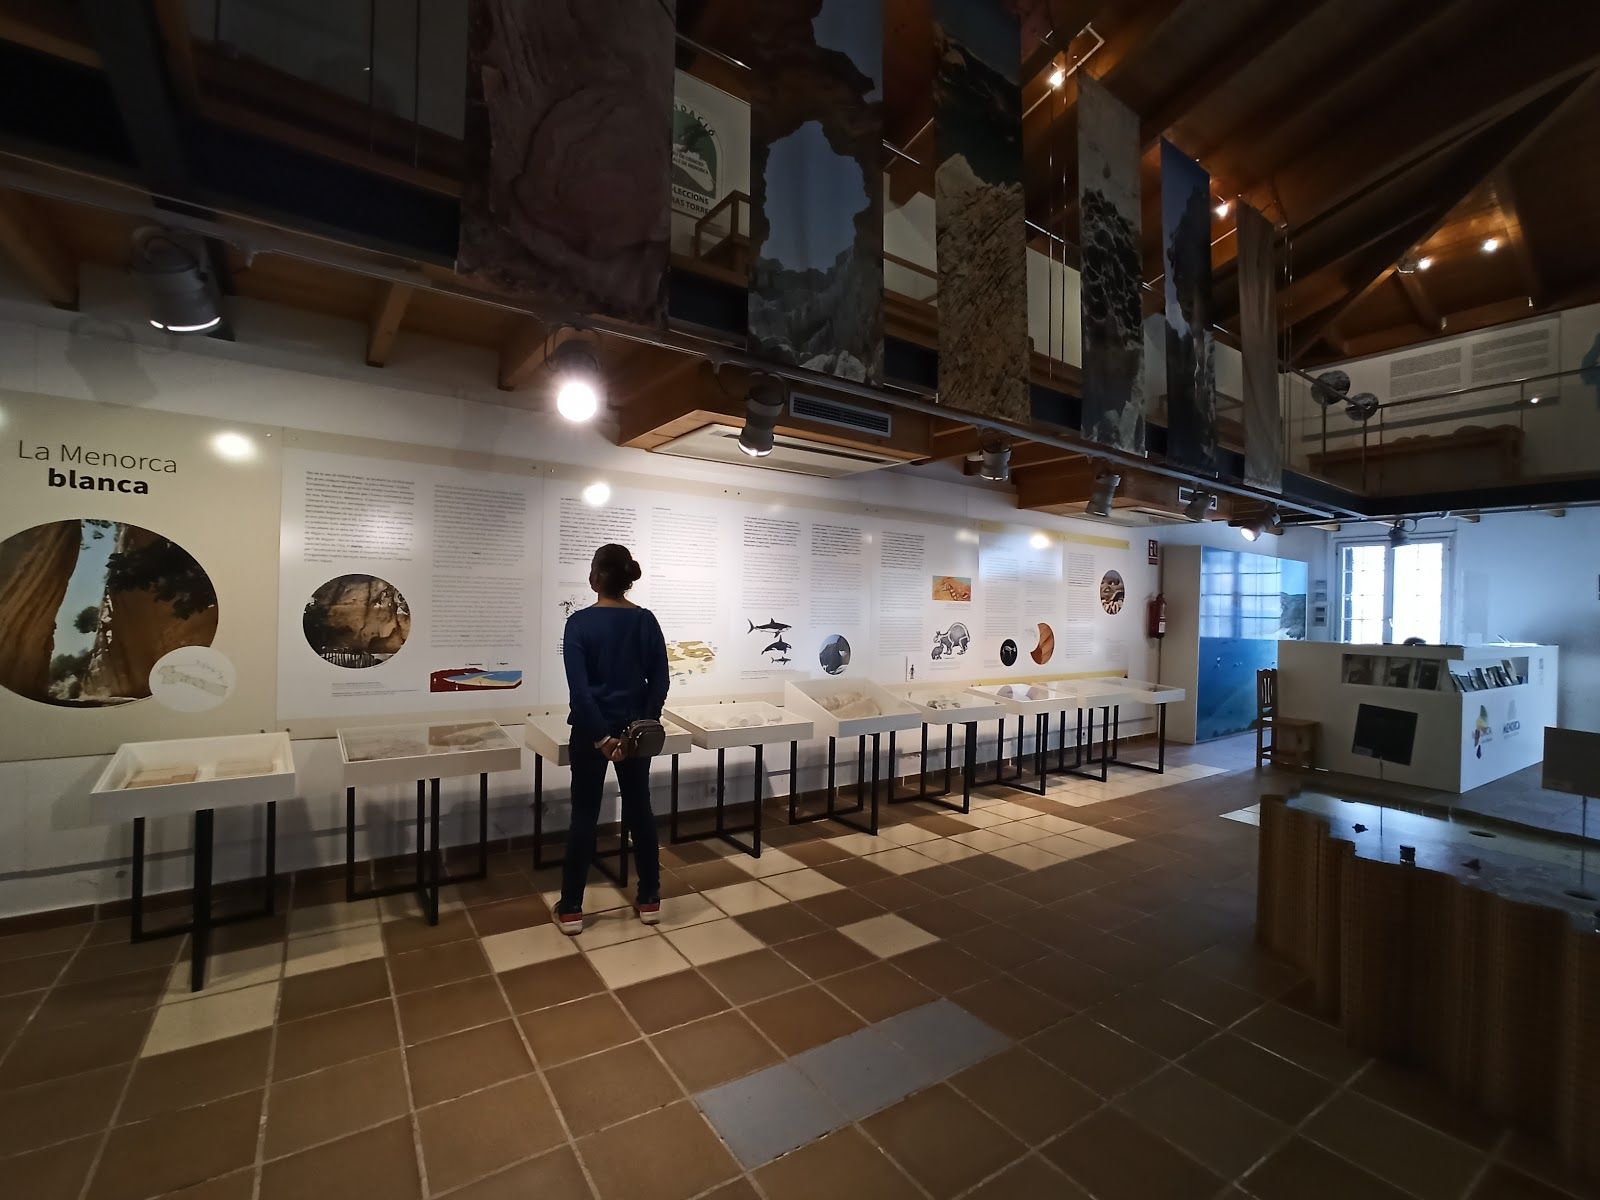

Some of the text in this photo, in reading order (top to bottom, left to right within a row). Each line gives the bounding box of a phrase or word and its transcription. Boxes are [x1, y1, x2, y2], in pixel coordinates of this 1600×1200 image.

[672, 186, 709, 205] LECCIONS
[685, 201, 708, 214] TORRE
[18, 440, 177, 474] La Menorca
[48, 467, 149, 495] blanca
